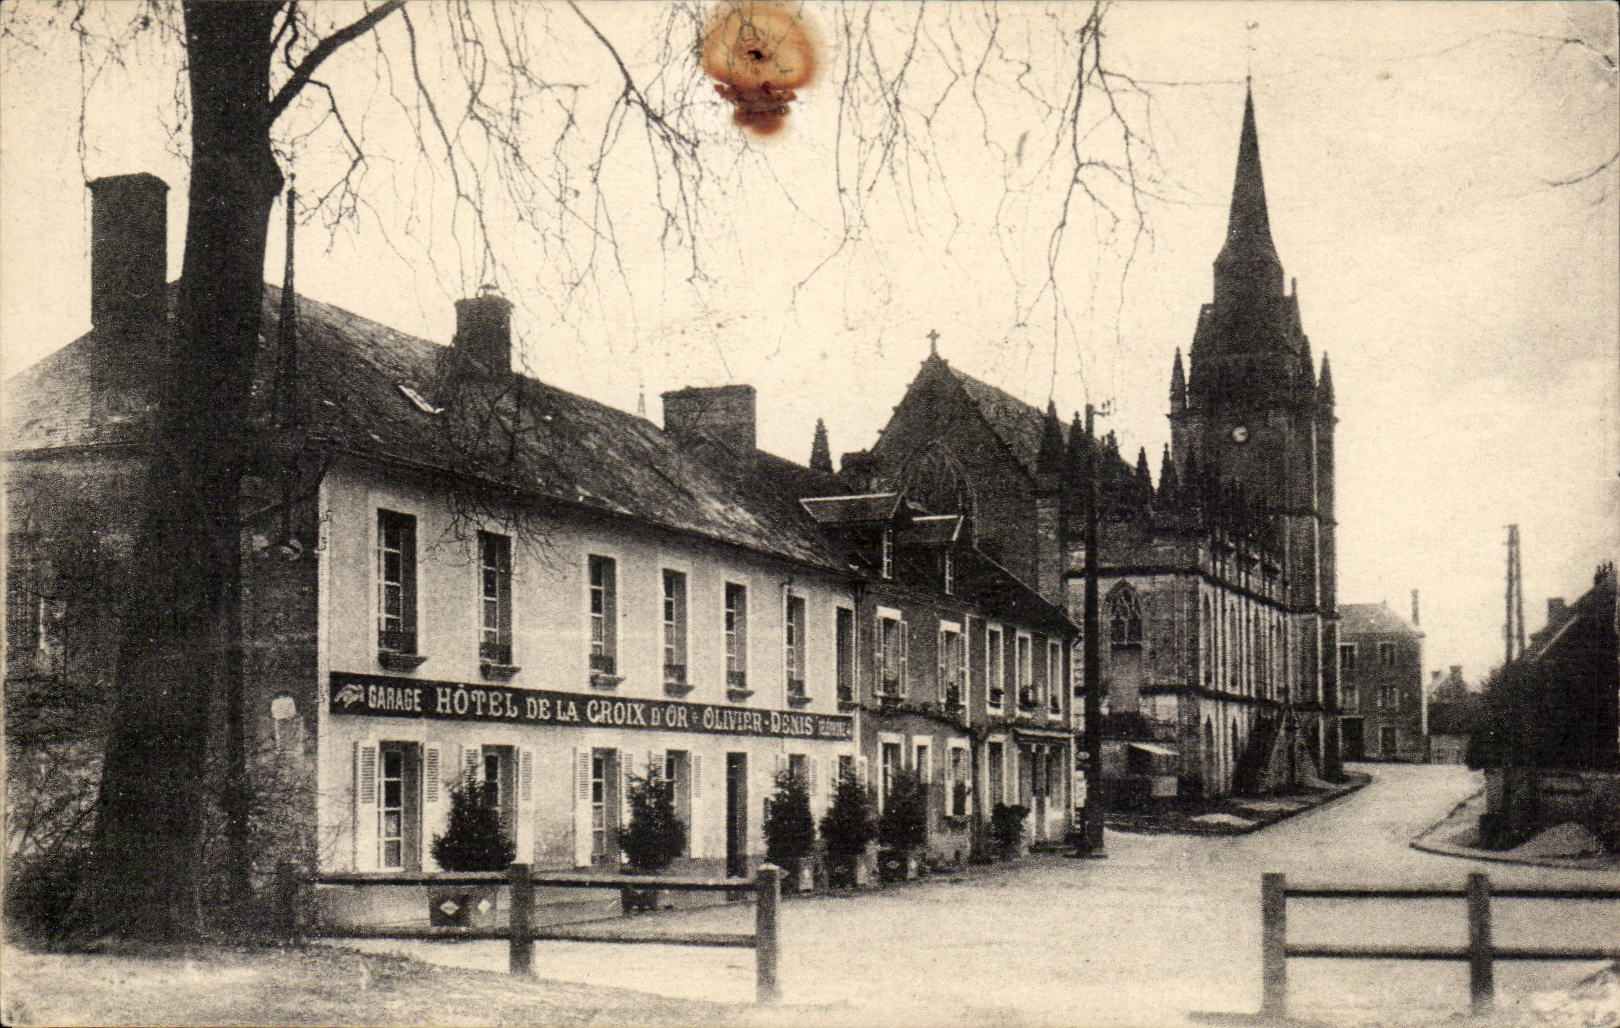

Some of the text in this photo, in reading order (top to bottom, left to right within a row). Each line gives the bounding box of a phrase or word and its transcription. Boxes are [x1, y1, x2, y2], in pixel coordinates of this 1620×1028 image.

[368, 684, 422, 712] GARAGE
[436, 683, 519, 718] HÔTEL
[525, 697, 551, 720] DE
[556, 699, 580, 722] LA
[586, 700, 646, 726] CROIX
[651, 704, 689, 729] D'OR
